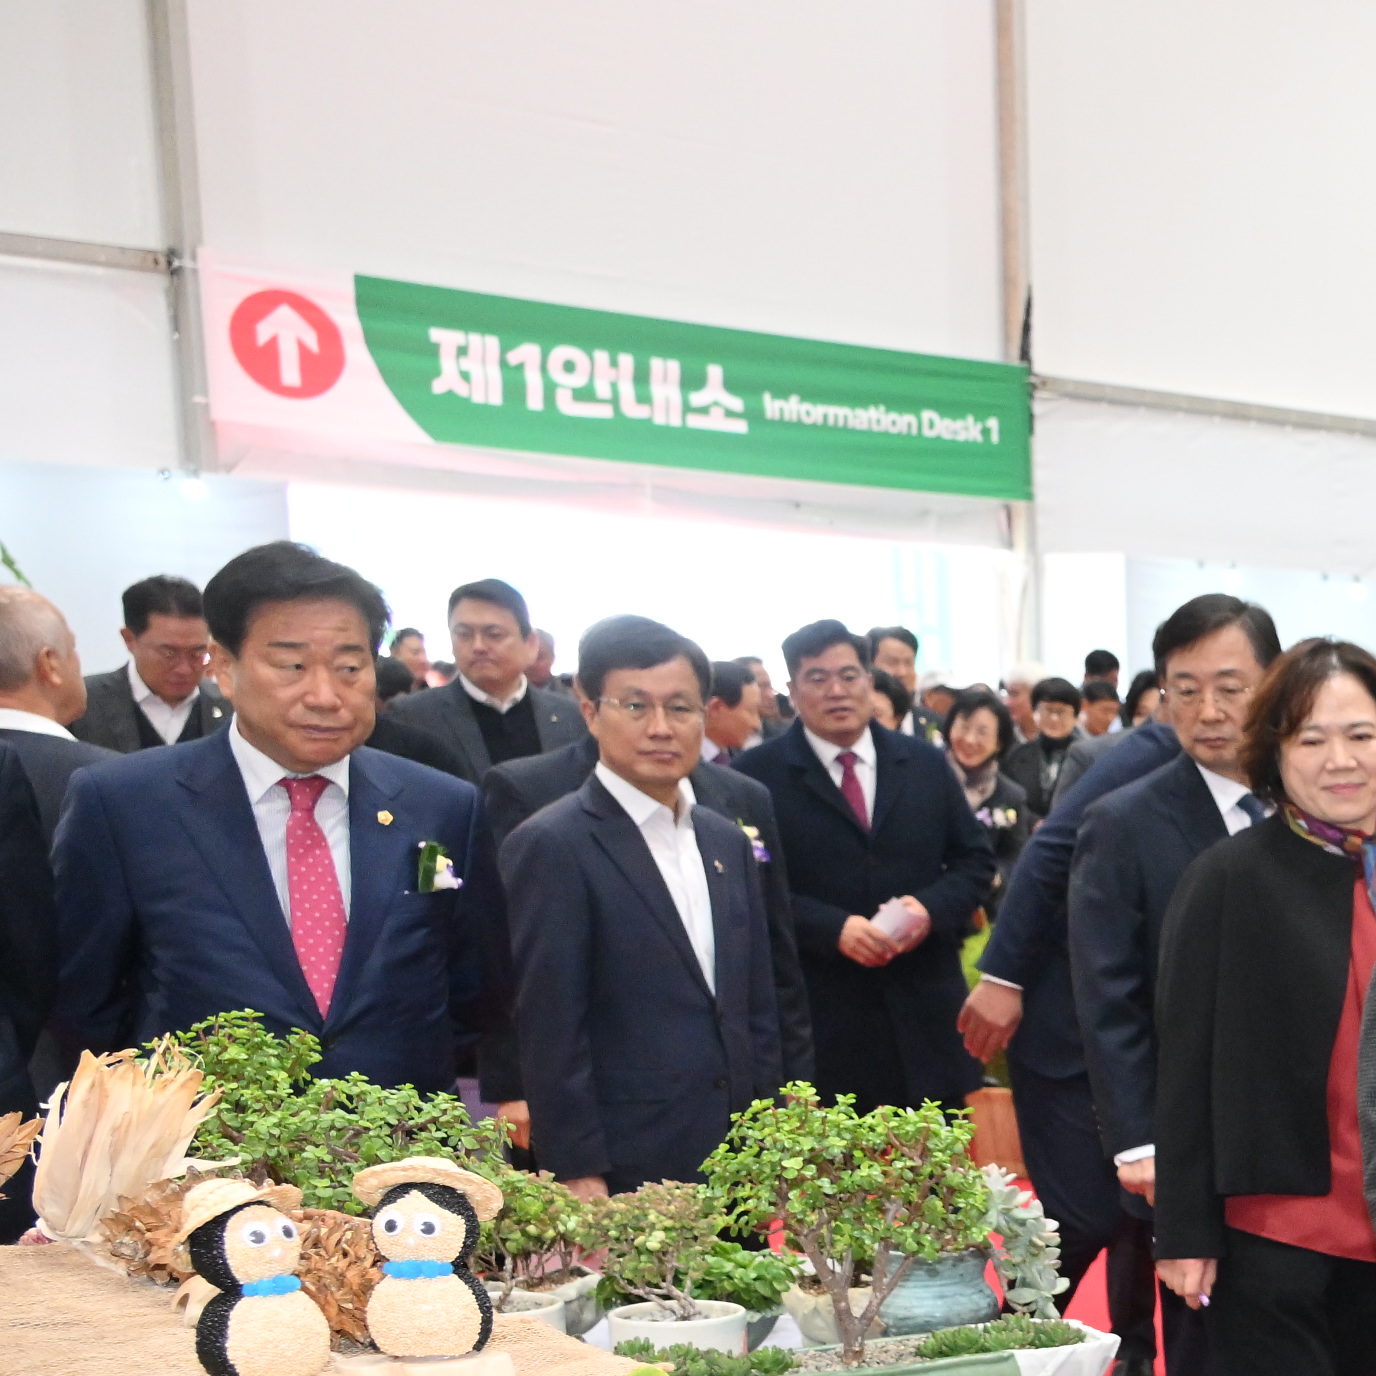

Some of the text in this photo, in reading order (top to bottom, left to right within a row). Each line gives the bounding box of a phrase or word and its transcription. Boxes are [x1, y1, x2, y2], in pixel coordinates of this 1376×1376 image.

[429, 325, 748, 435] 제1안내소
[763, 391, 1000, 444] Information Desk 1
